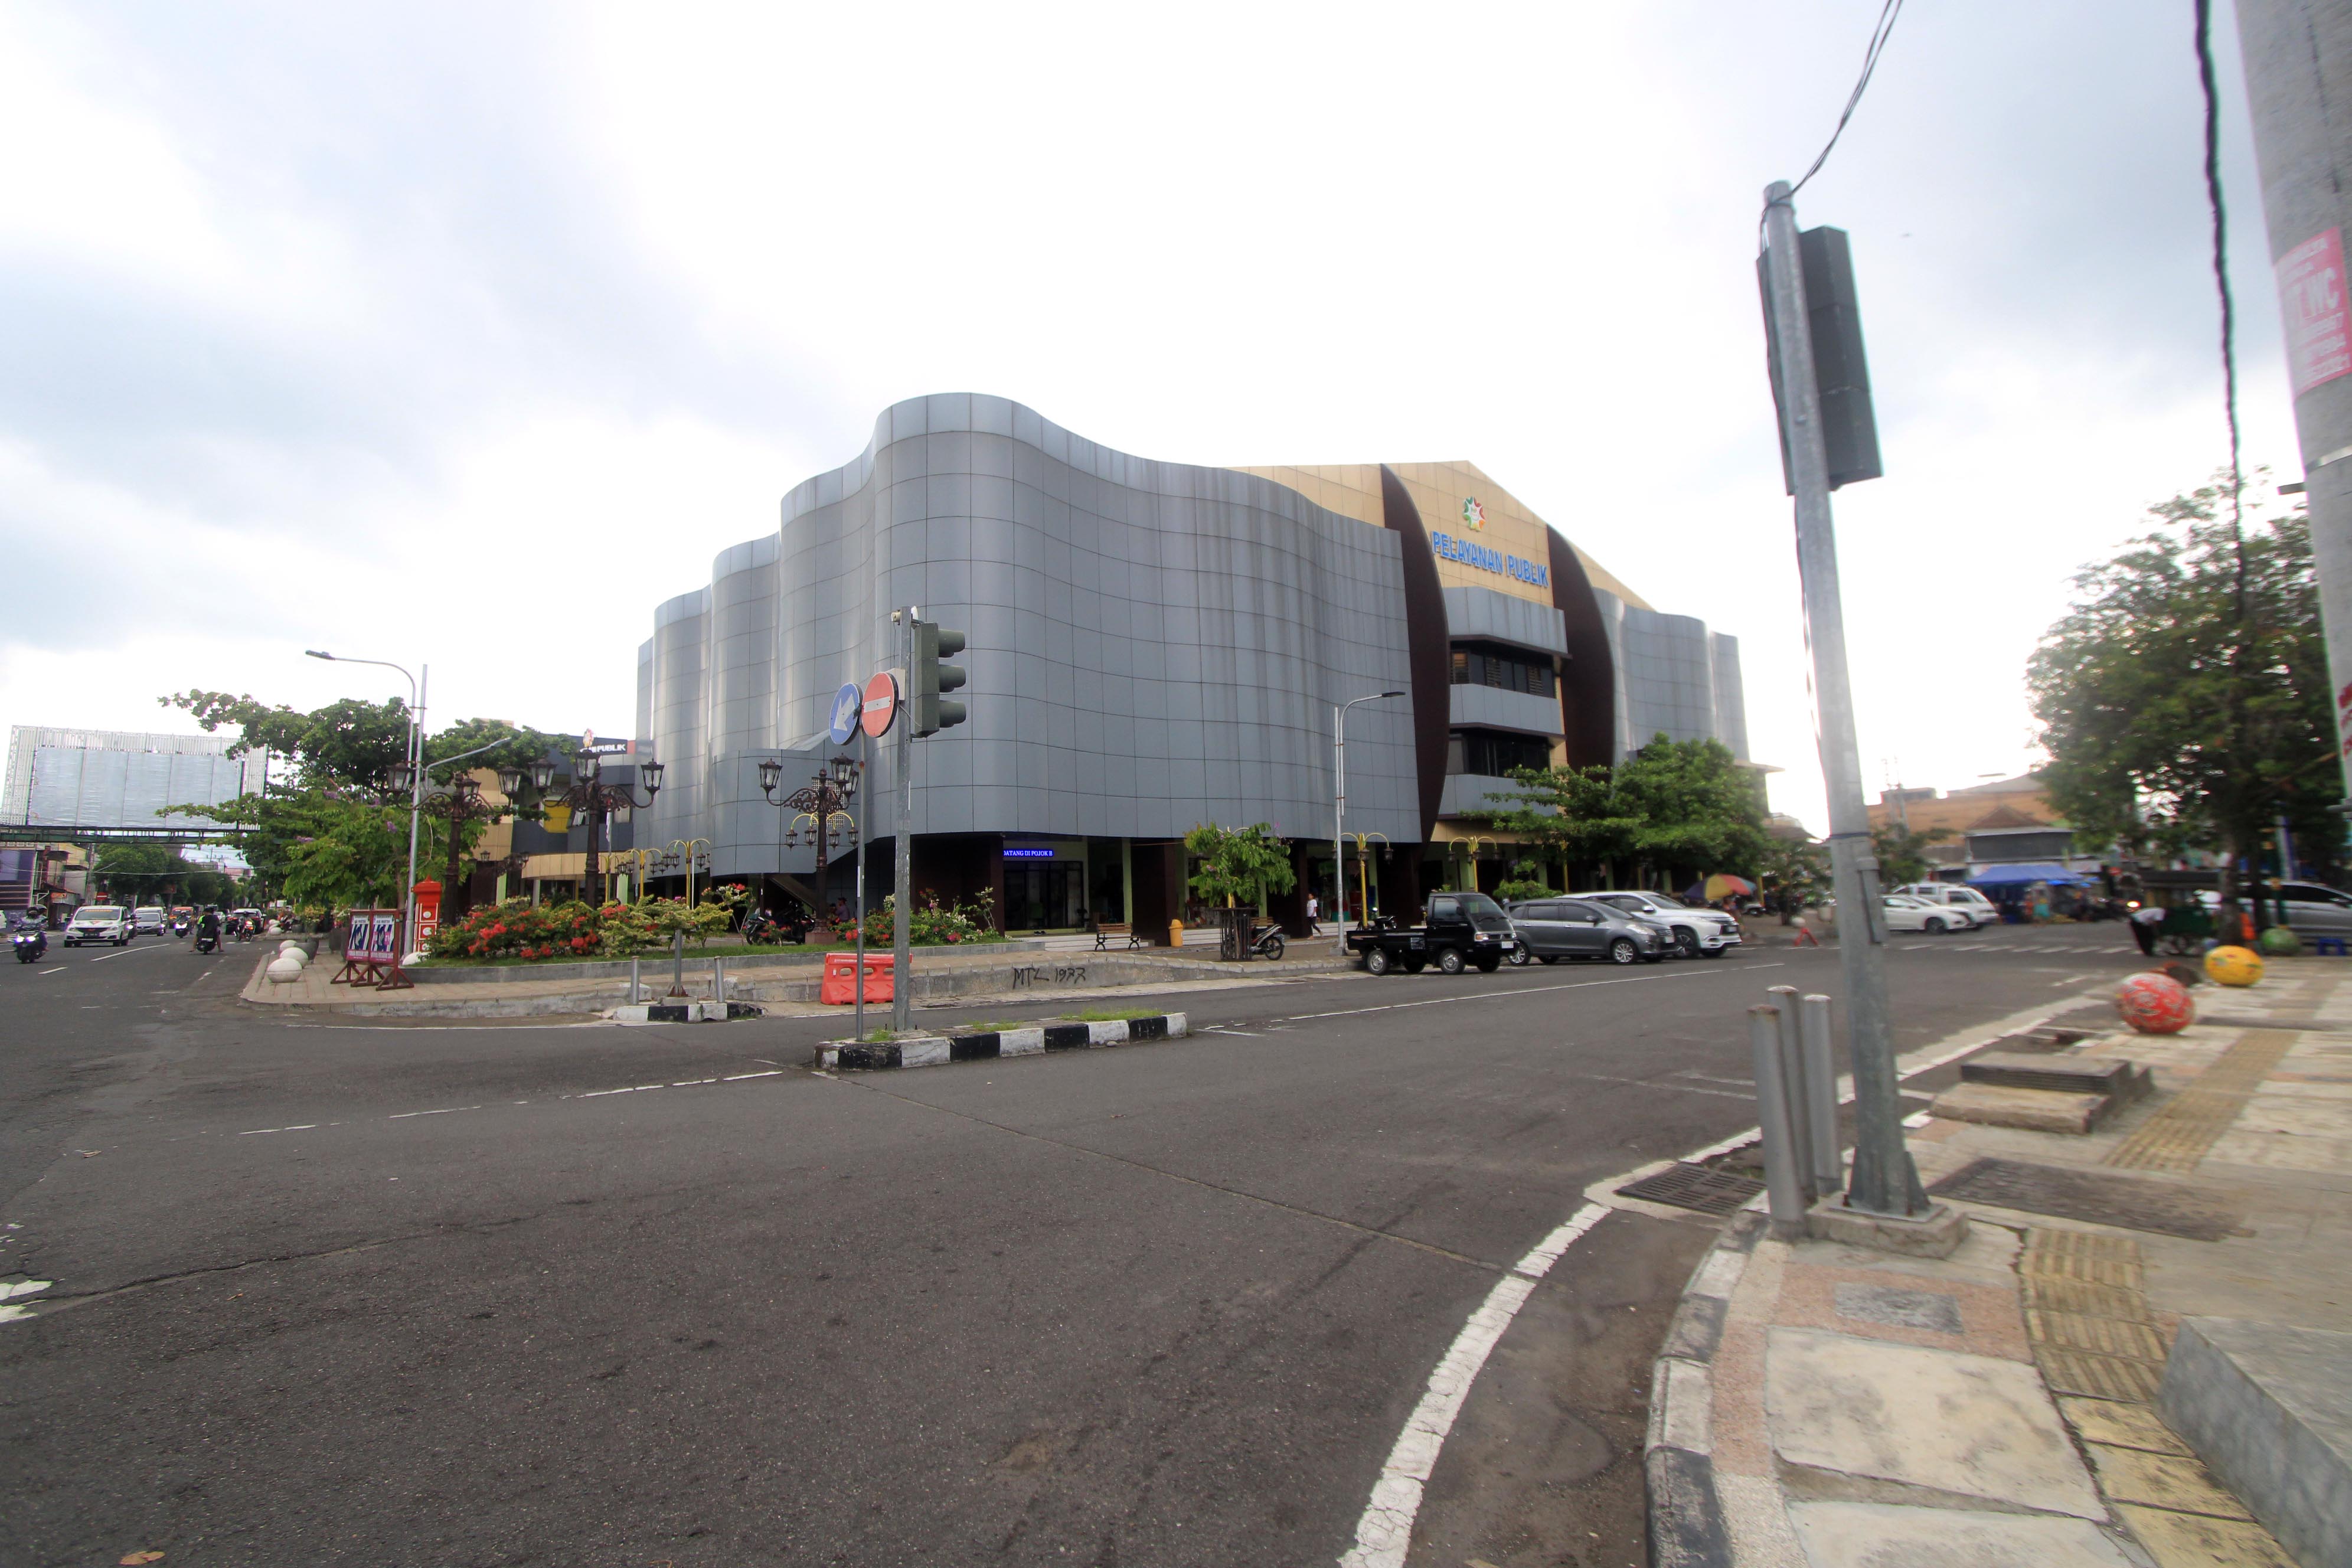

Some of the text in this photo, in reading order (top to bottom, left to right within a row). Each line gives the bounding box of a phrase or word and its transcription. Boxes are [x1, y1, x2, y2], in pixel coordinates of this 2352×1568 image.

[1431, 531, 1549, 588] PELAYANAN PUBLIK
[597, 744, 626, 753] PUBLIK
